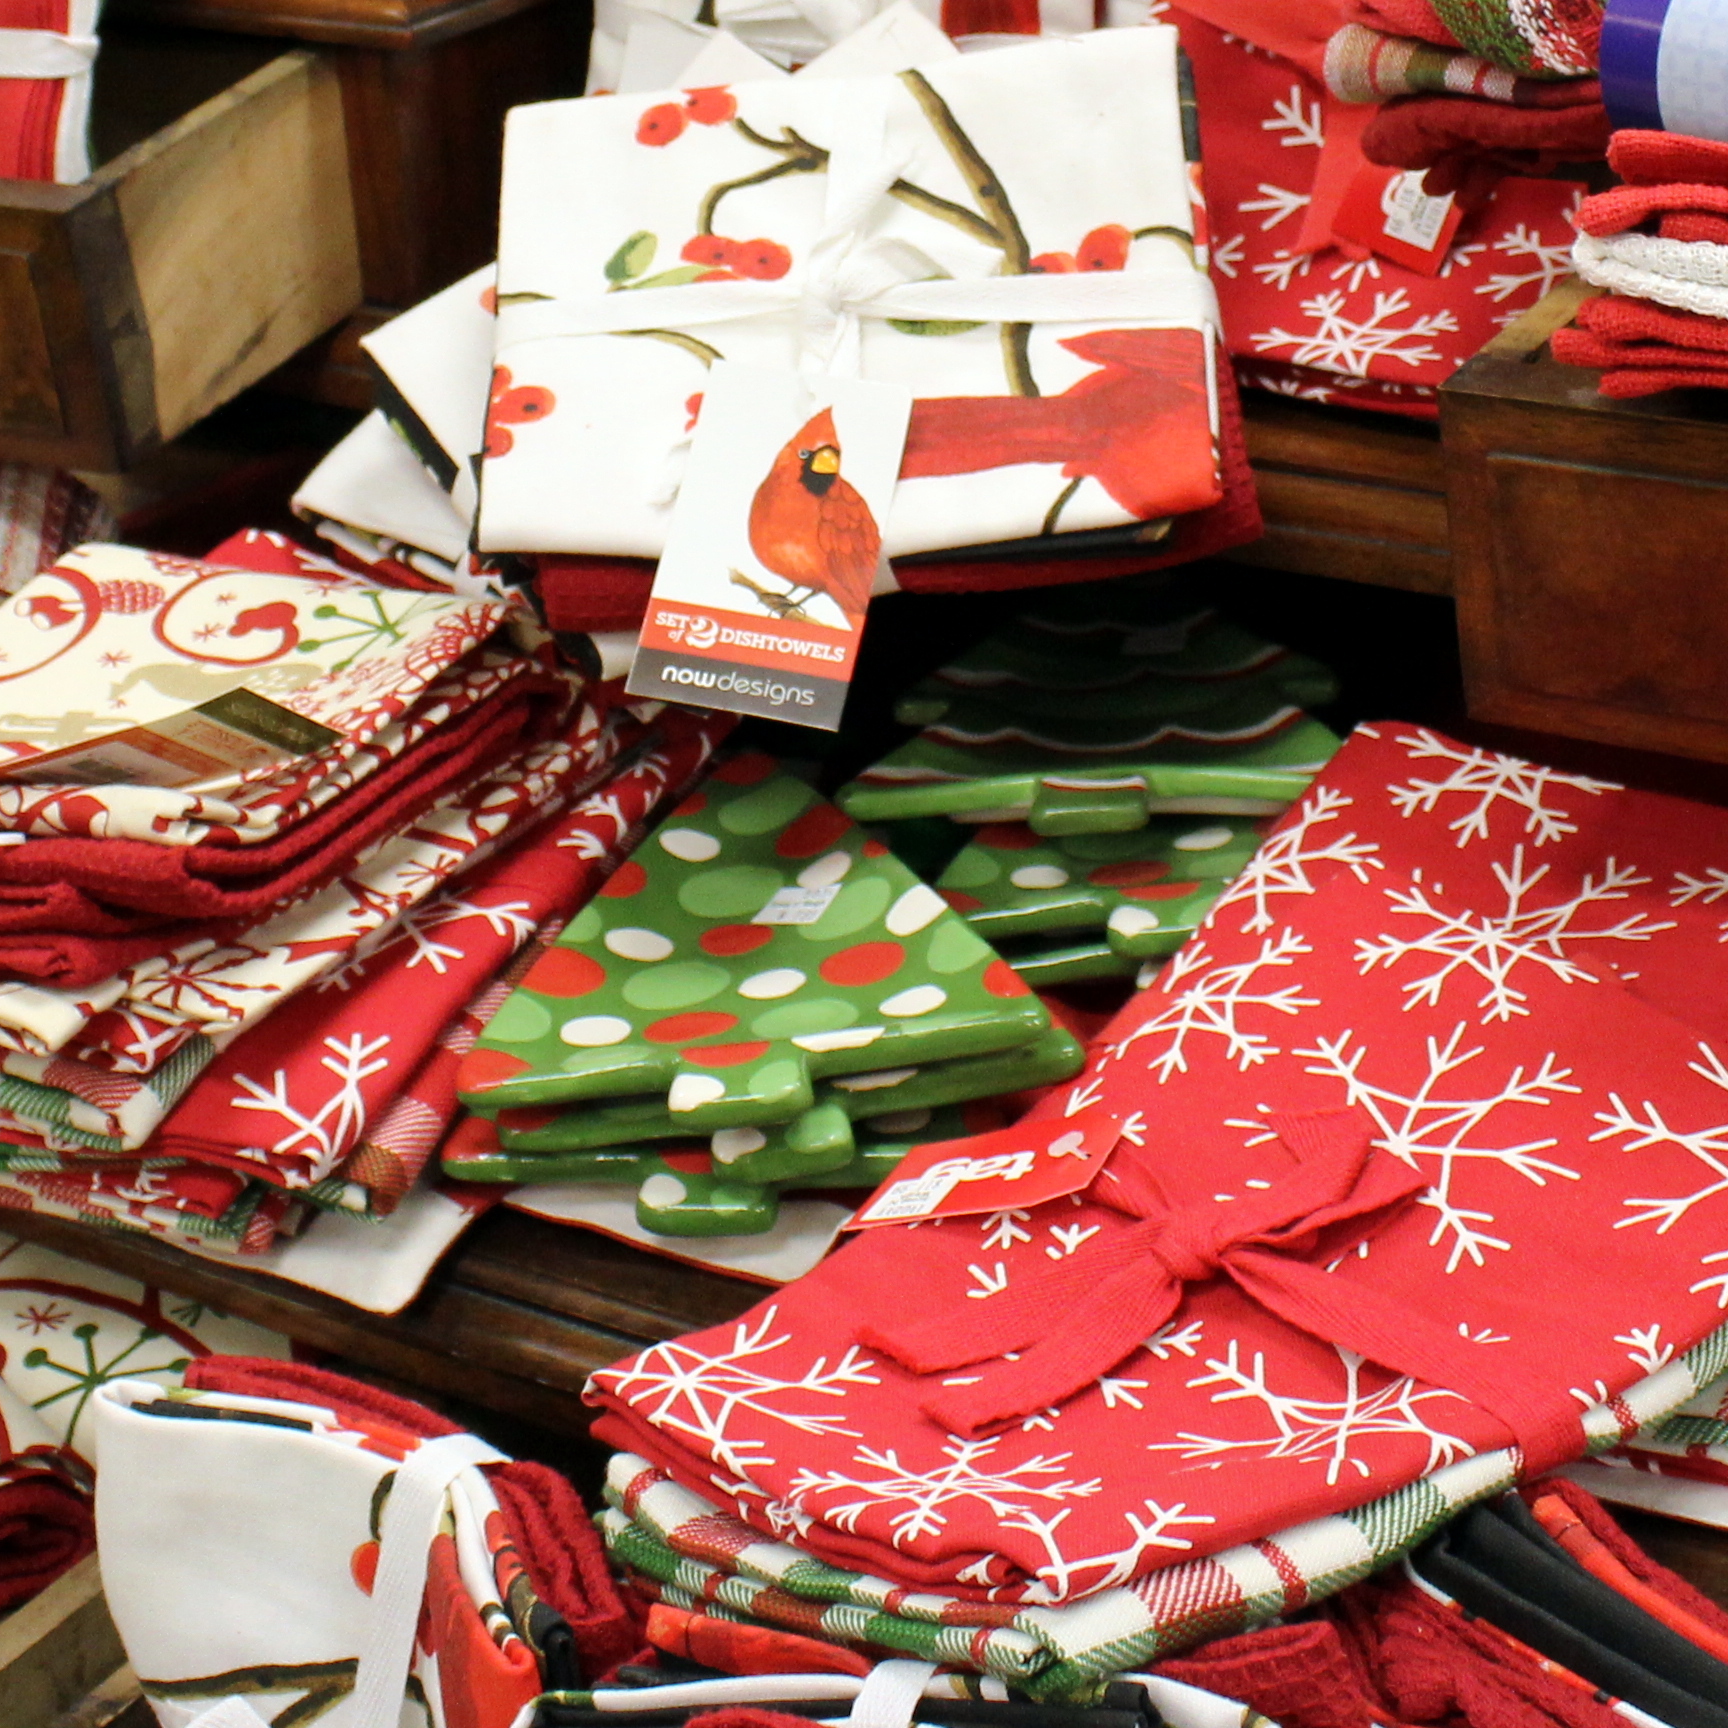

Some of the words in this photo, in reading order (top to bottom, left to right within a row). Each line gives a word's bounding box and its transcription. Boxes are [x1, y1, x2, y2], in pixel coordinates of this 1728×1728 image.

[655, 611, 691, 630] SET
[684, 615, 720, 650] 2
[719, 628, 847, 663] DISHTOWELS
[668, 629, 684, 643] of
[661, 664, 816, 707] nowdesigns
[921, 1150, 1037, 1182] tag
